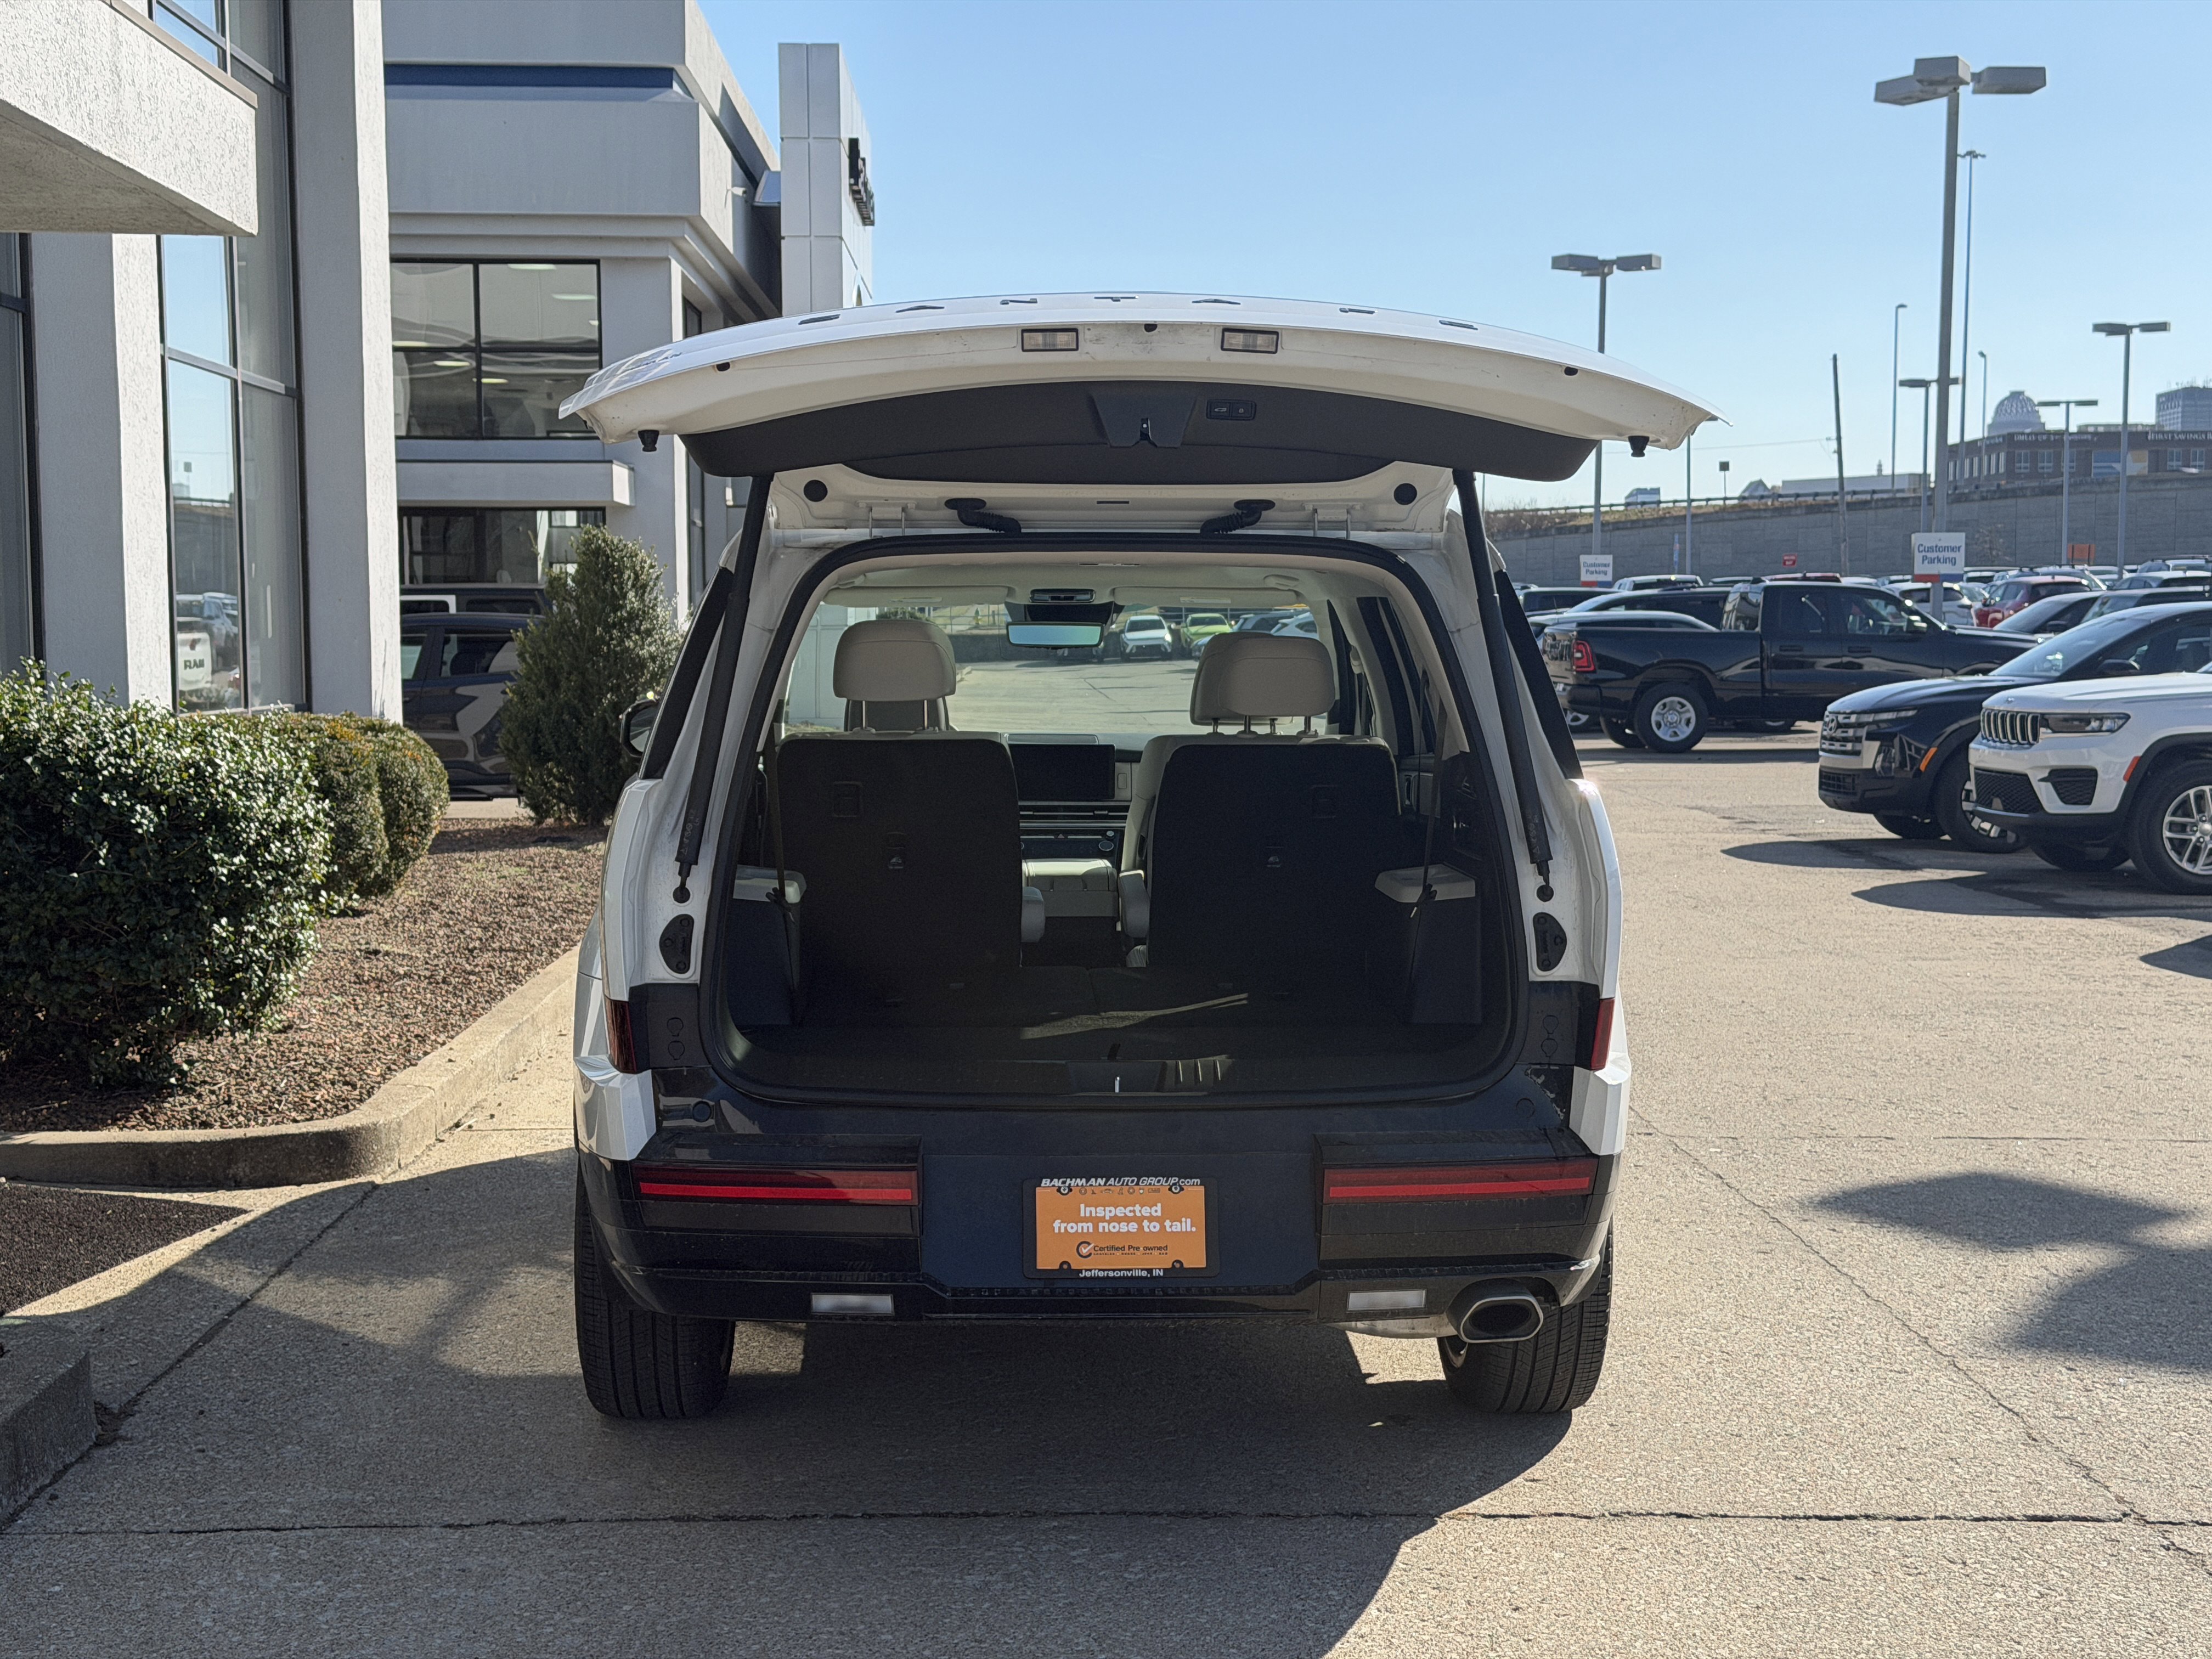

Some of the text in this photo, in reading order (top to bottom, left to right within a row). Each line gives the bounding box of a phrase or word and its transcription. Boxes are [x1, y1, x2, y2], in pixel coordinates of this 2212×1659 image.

[1917, 543, 1962, 553] Customer
[1922, 555, 1956, 566] Parking
[184, 658, 205, 670] RAM
[1041, 1178, 1105, 1187] BACHMAN
[1106, 1177, 1137, 1186] AUTO
[1080, 1203, 1161, 1220] Inspected
[1053, 1217, 1197, 1233] from nose to tail.
[1079, 1268, 1164, 1278] Jeffersonville, IN
